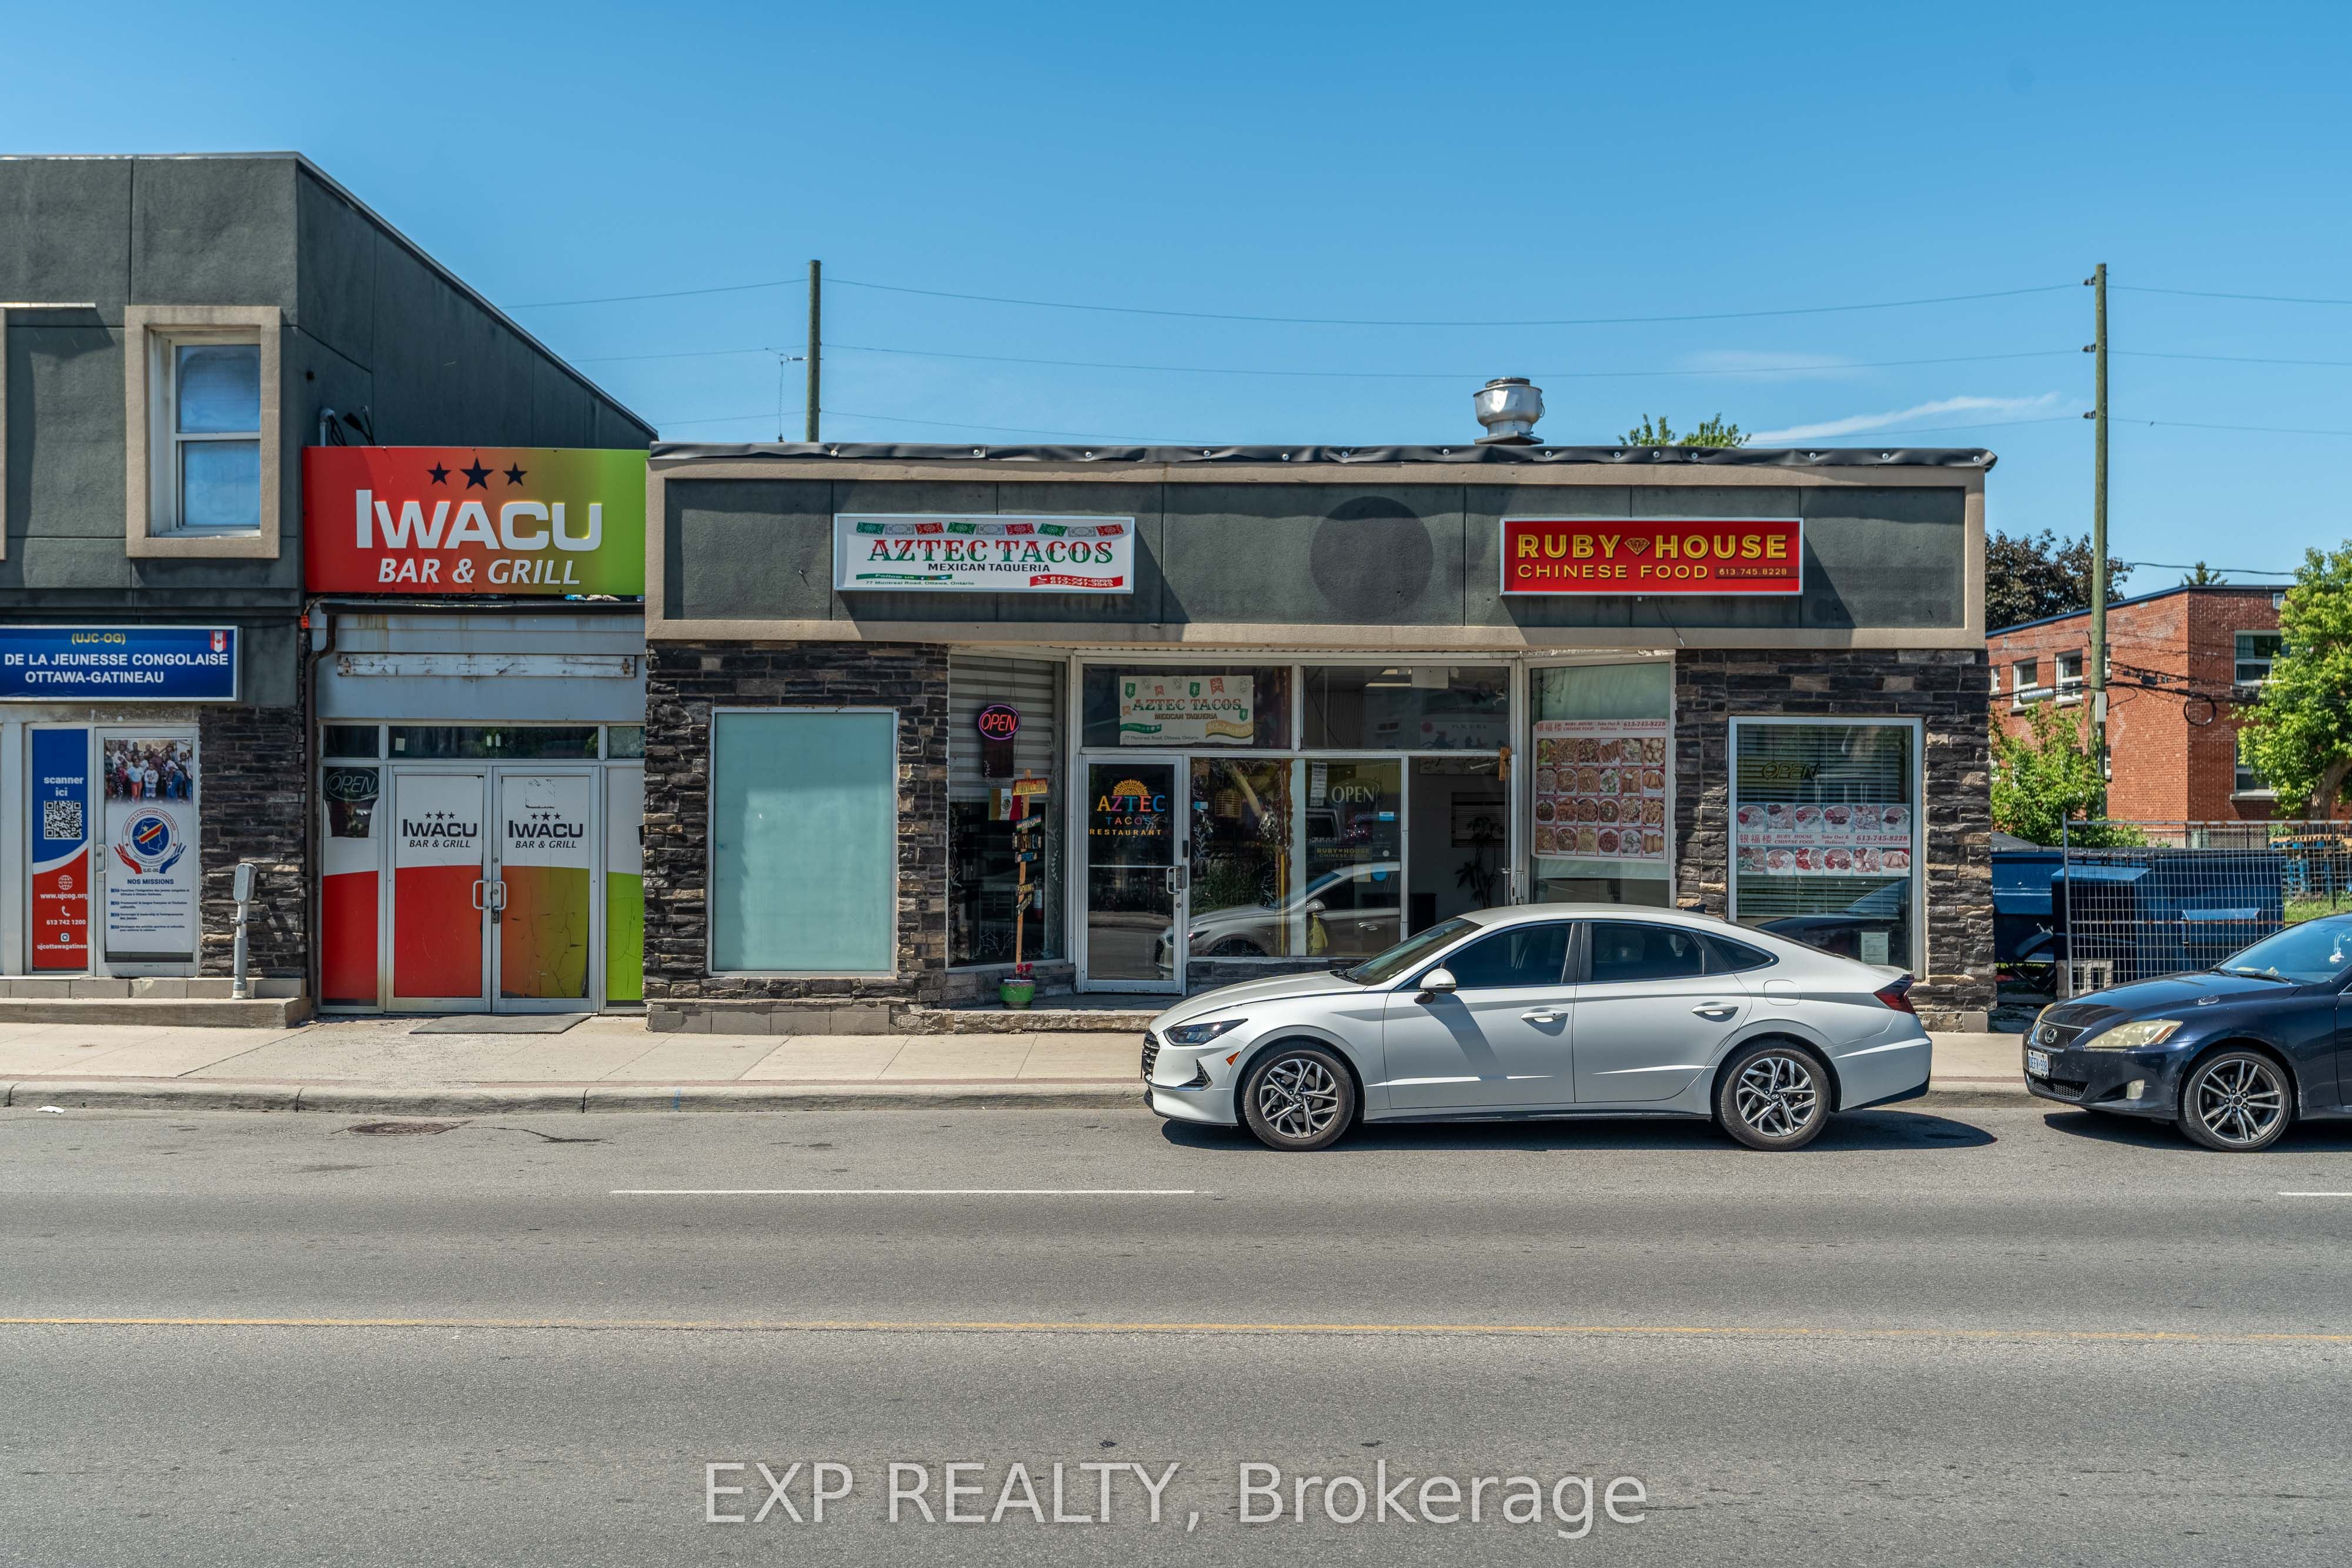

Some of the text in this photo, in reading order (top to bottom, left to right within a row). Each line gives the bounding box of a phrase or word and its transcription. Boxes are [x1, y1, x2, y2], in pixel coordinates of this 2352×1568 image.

[356, 489, 602, 551] IWACU
[867, 539, 1113, 564] AZTEC TACOS
[1518, 534, 1787, 560] RUBY HOUSE
[378, 558, 580, 584] BAR & GRILL
[928, 563, 1050, 573] MEXICAN TAQUERIA
[1518, 564, 1708, 579] CHINESE FOOD
[1719, 567, 1788, 576] 613.745.8228
[71, 633, 125, 646] (UJC-OG)
[5, 653, 228, 666] DE LA JEUNESSE CONGOLAISE
[25, 671, 164, 683] OTTAWA-GATINEAU
[1132, 698, 1242, 711] AZTEC TACOS
[981, 714, 1017, 731] OPEN
[1762, 762, 1820, 781] OPEN
[55, 787, 68, 796] ici
[329, 775, 376, 793] OPEN
[1331, 786, 1374, 803] OPEN
[1097, 795, 1165, 812] AZTEC
[403, 819, 477, 837] IWACU
[1105, 816, 1151, 825] TACOS
[509, 820, 583, 838] IWACU
[409, 840, 429, 848] BAR
[432, 840, 440, 848] &
[1740, 834, 1772, 844] 银福楼
[40, 892, 88, 900] www.ujcog.org
